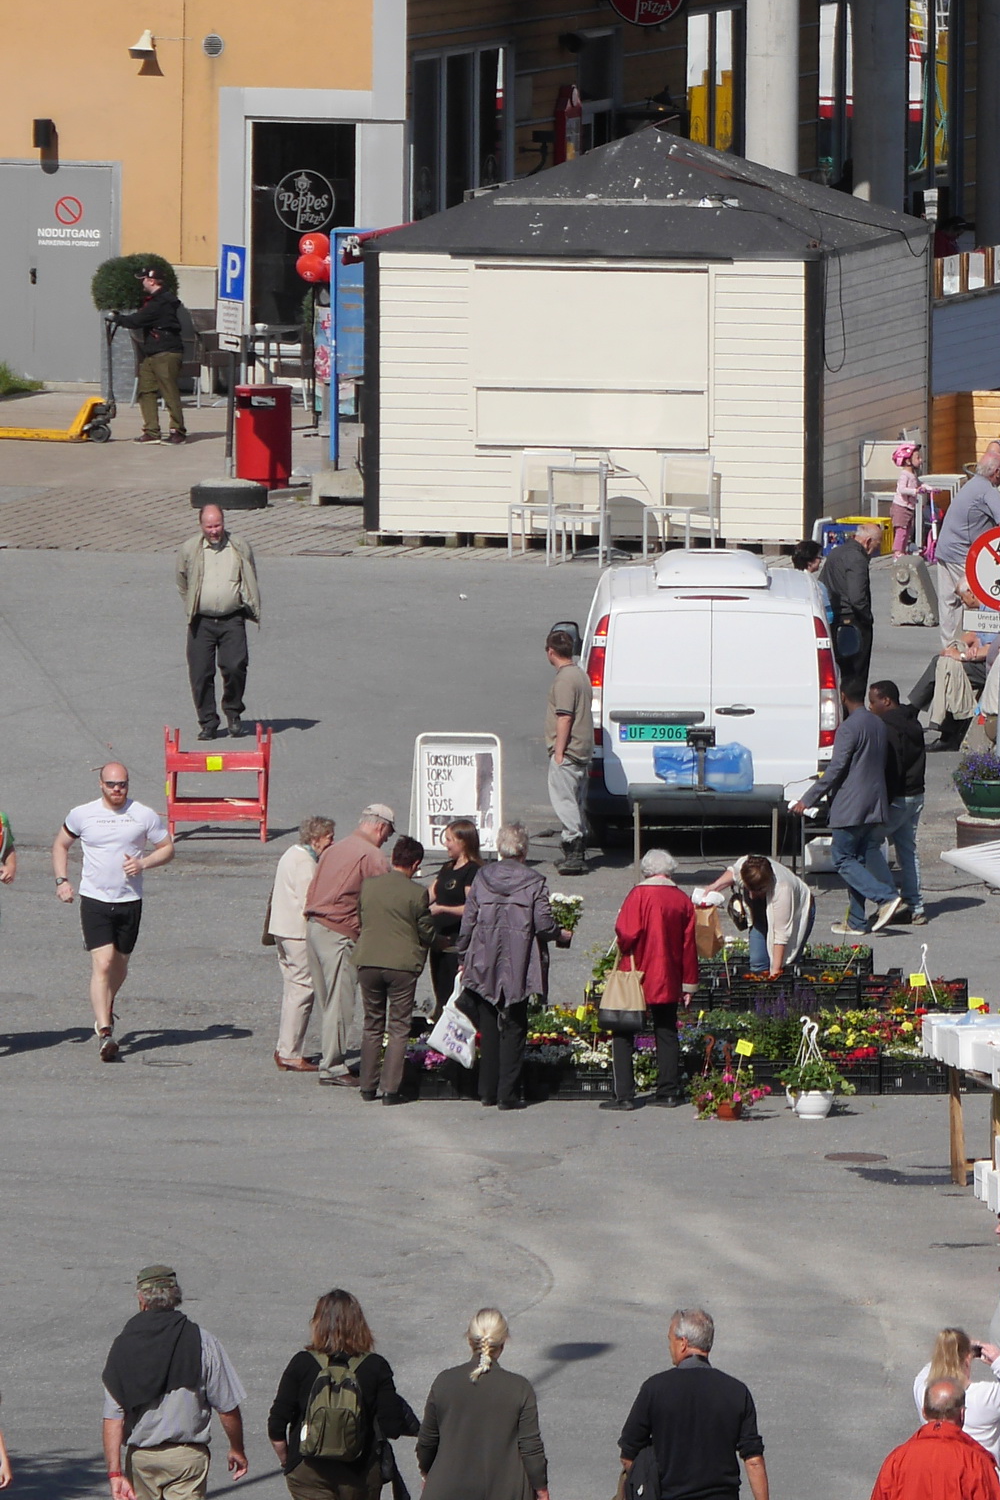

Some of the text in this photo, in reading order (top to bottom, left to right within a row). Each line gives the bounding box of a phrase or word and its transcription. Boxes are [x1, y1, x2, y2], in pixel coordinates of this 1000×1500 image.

[279, 191, 329, 213] Peppes
[37, 228, 101, 239] NØDUTGANG
[226, 252, 241, 293] P
[629, 727, 645, 739] UF
[427, 768, 454, 781] TORSK
[428, 798, 454, 813] HYSE
